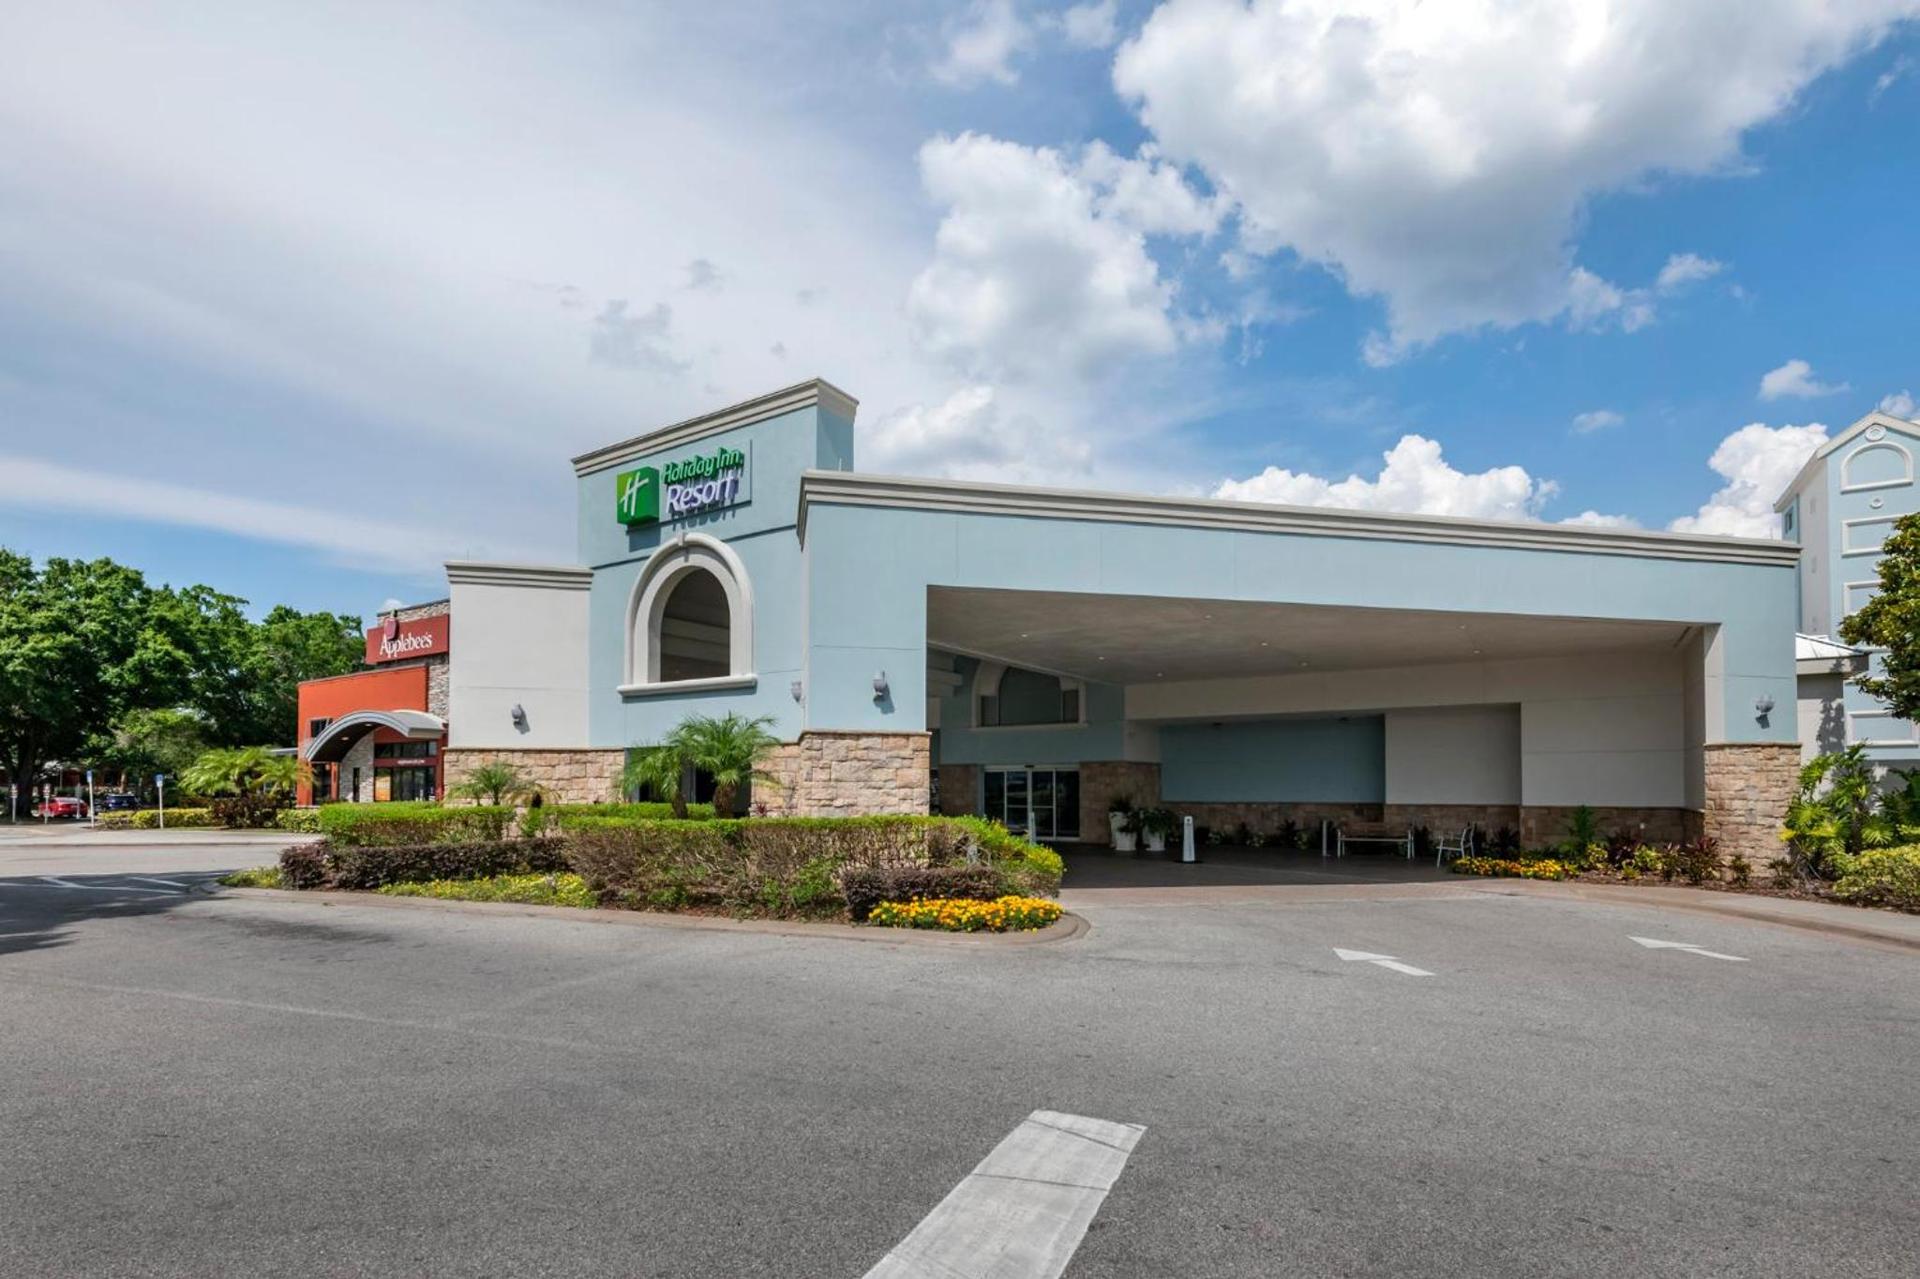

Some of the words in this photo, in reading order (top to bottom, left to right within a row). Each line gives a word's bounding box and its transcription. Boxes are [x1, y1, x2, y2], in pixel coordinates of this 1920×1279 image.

[662, 454, 715, 483] Holiday
[716, 447, 742, 468] Inn
[665, 473, 735, 513] Resort
[379, 632, 432, 658] Applebee's
